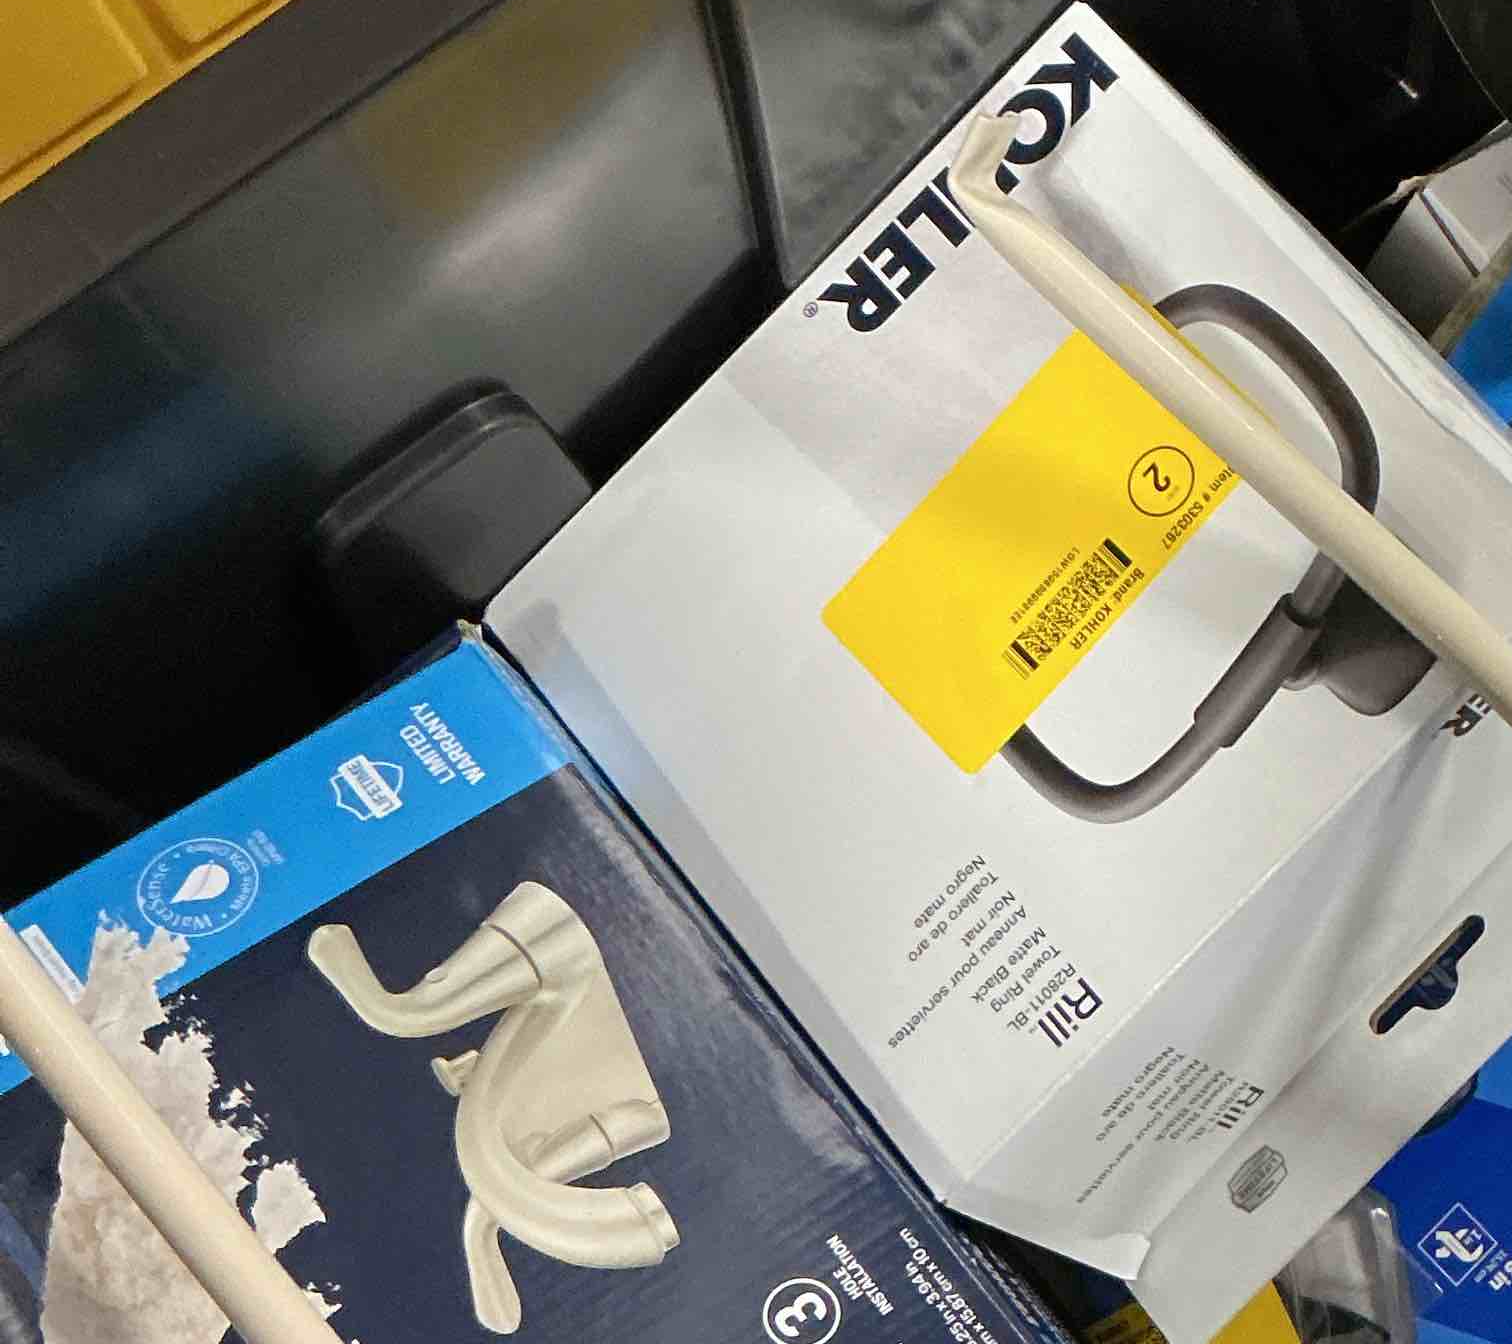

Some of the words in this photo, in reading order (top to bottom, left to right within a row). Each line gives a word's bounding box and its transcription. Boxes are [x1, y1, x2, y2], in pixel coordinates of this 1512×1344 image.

[1141, 462, 1172, 493] 2
[1070, 603, 1112, 650] KOHLER
[400, 725, 455, 784] LIMITED
[411, 703, 485, 784] WARRANTY
[946, 855, 986, 895] Negro
[912, 894, 946, 929] mate
[948, 872, 999, 921] Toallero
[985, 889, 1016, 921] Noir
[928, 919, 949, 940] de
[959, 917, 987, 947] mat
[979, 905, 1026, 956] Anneau
[1006, 926, 1046, 966] Matte
[906, 938, 930, 962] aro
[1021, 945, 1061, 984] Towel
[947, 951, 980, 987] pour
[971, 965, 1010, 1003] Black
[989, 979, 1024, 1014] Ring
[1007, 963, 1076, 1030] R28011-BL
[1038, 978, 1102, 1047] Rill
[888, 986, 949, 1048] serviettes
[1216, 1086, 1265, 1129] Rill
[898, 1227, 919, 1249] cm
[912, 1246, 930, 1265] 10
[827, 1235, 893, 1315] INSTALLATION
[833, 1266, 863, 1300] HOLE
[903, 1260, 919, 1276] in
[932, 1269, 953, 1292] cm
[1487, 1270, 1511, 1292] in
[912, 1273, 940, 1305] 3.94
[772, 1289, 829, 1339] 3
[941, 1309, 957, 1325] in
[945, 1291, 977, 1325] 15.87
